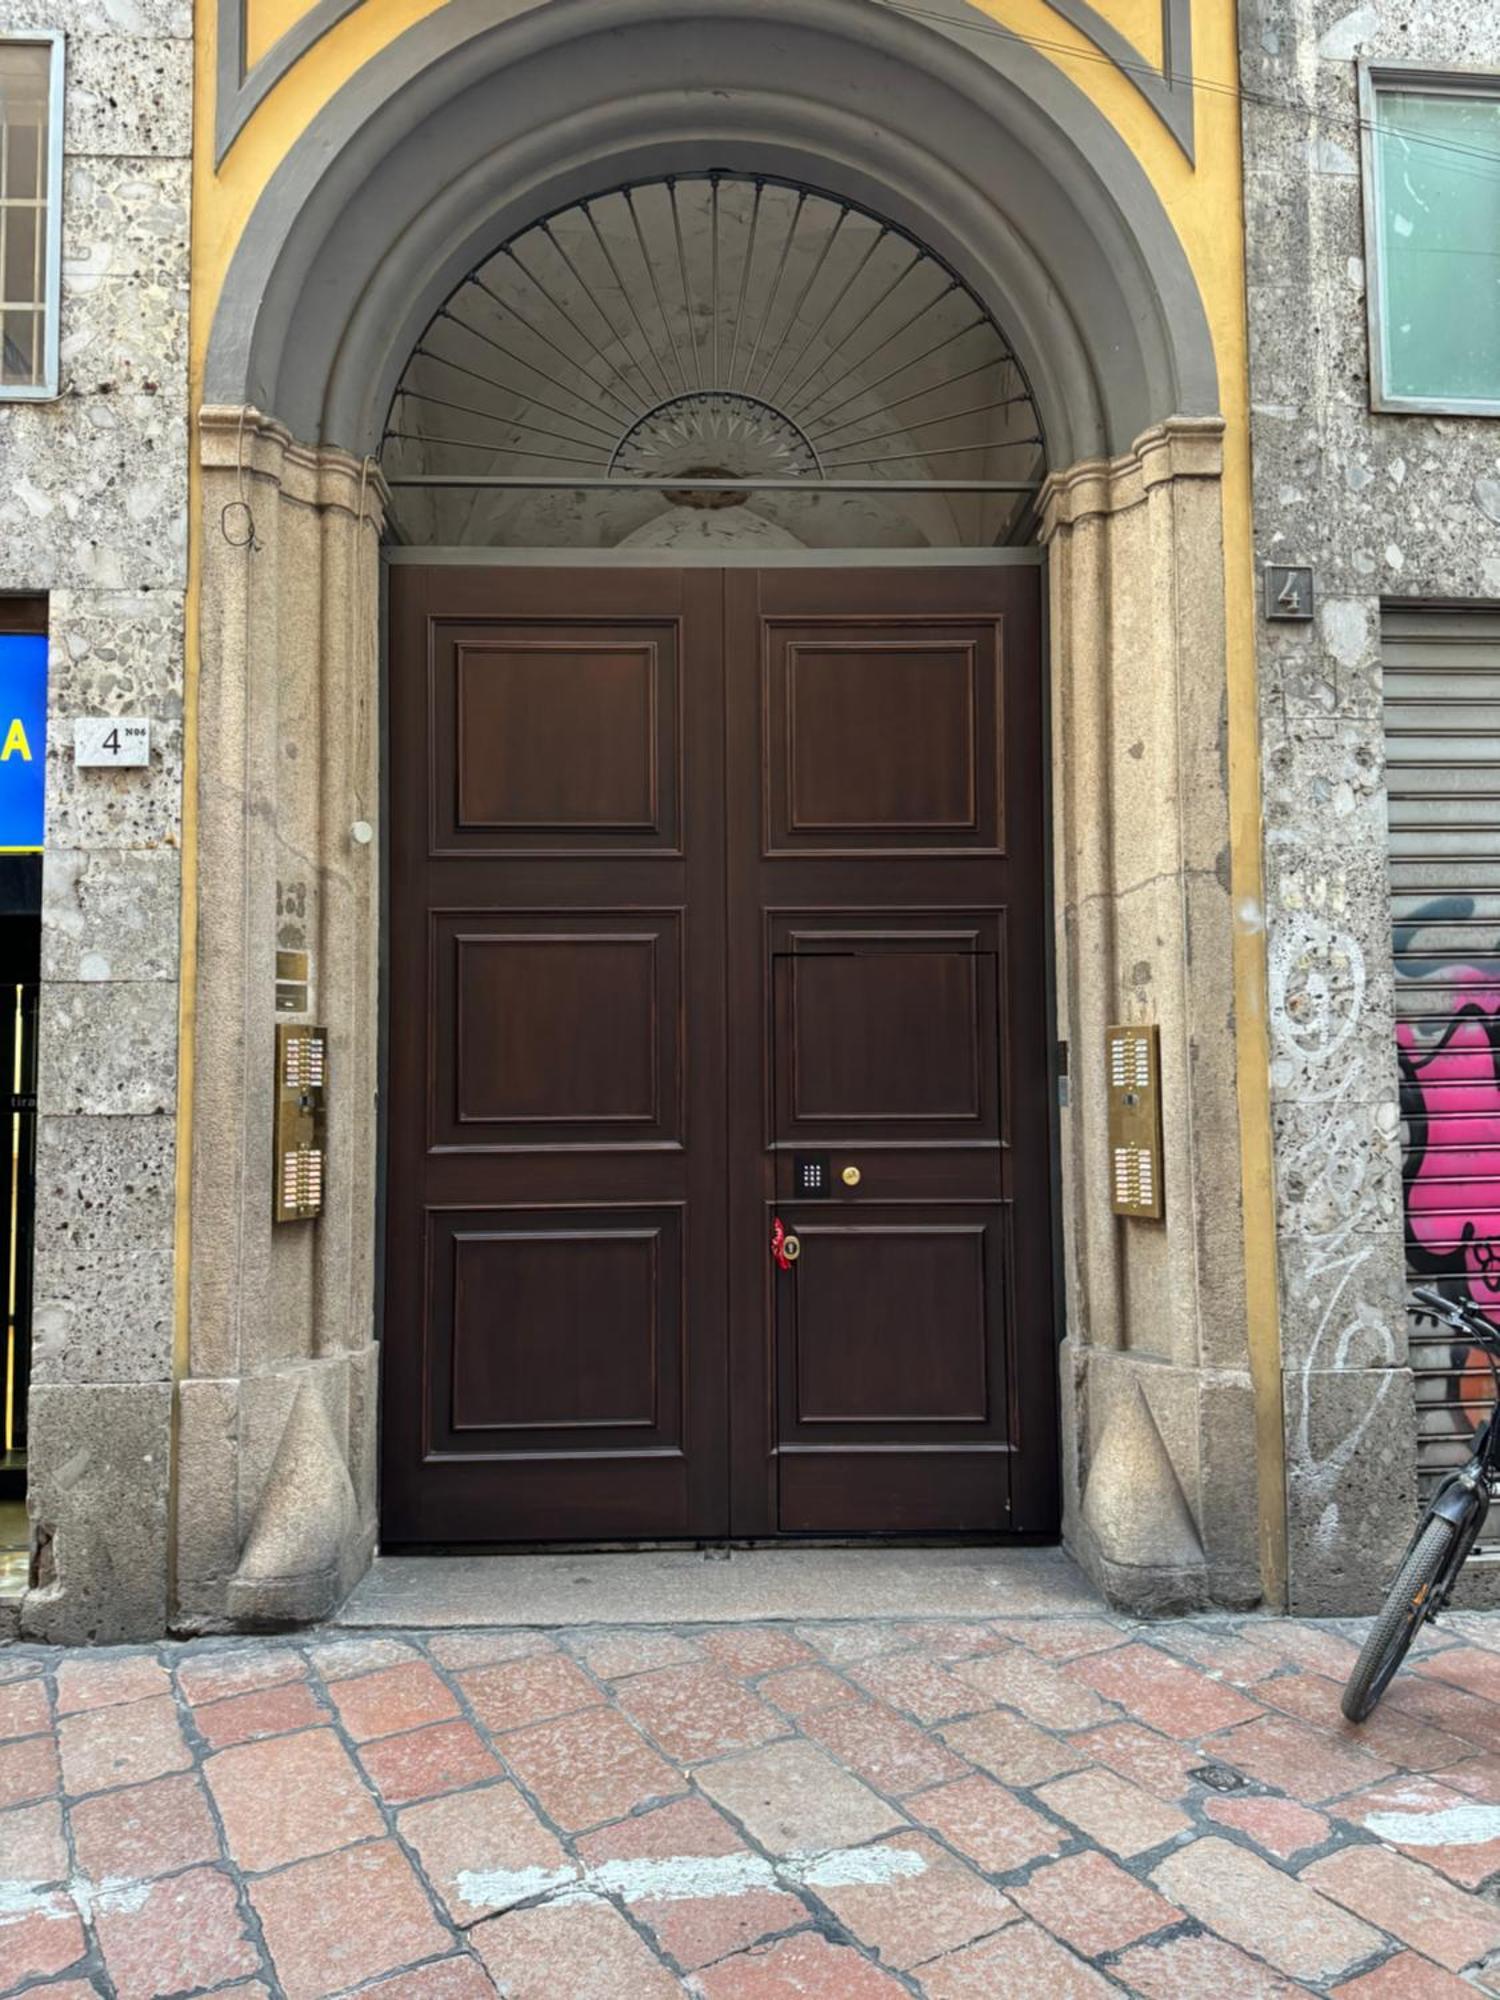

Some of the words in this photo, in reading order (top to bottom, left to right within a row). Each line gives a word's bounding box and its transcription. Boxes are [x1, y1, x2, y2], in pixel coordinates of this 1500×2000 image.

[1278, 571, 1300, 608] 4
[0, 719, 32, 761] A
[102, 728, 121, 755] 4
